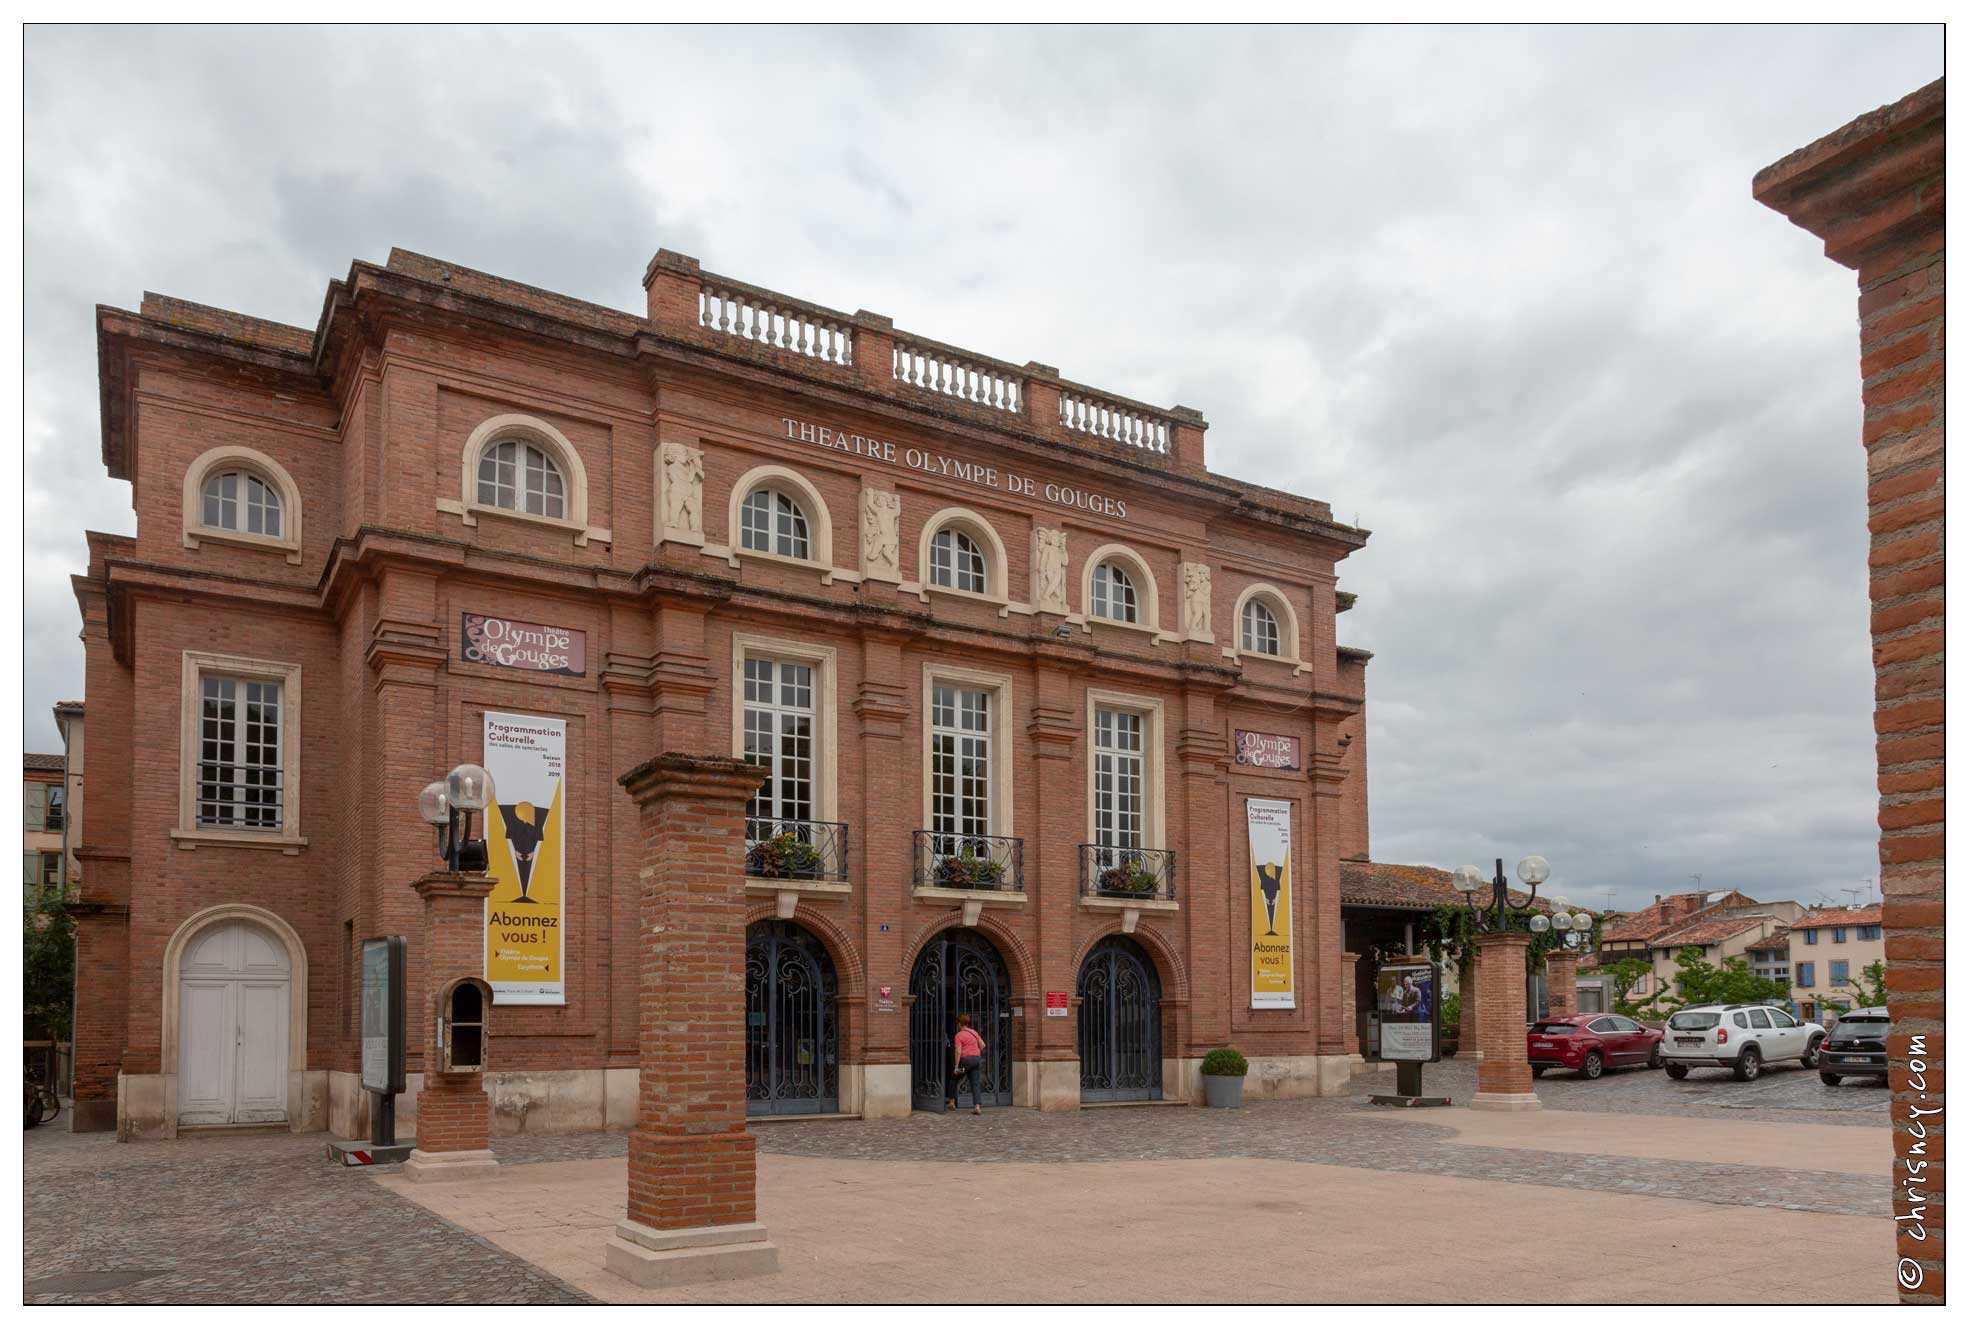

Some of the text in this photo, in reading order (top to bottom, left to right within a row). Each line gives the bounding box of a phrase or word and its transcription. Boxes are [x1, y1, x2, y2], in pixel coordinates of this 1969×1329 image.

[782, 418, 1127, 518] THEATRE OLYMPE DE GOUGES
[484, 619, 570, 652] Olympe
[481, 640, 569, 670] de Gouges
[488, 721, 561, 737] Programmation
[488, 732, 535, 744] Culturelle
[1245, 732, 1291, 755] Olympe
[1245, 748, 1291, 768] de Gouges
[1250, 806, 1288, 815] Programmation
[1250, 813, 1275, 821] Culturelle
[489, 912, 558, 928] Abonnez
[501, 929, 546, 943] vous !
[1253, 941, 1290, 953] Abonnez
[1260, 957, 1280, 965] vous
